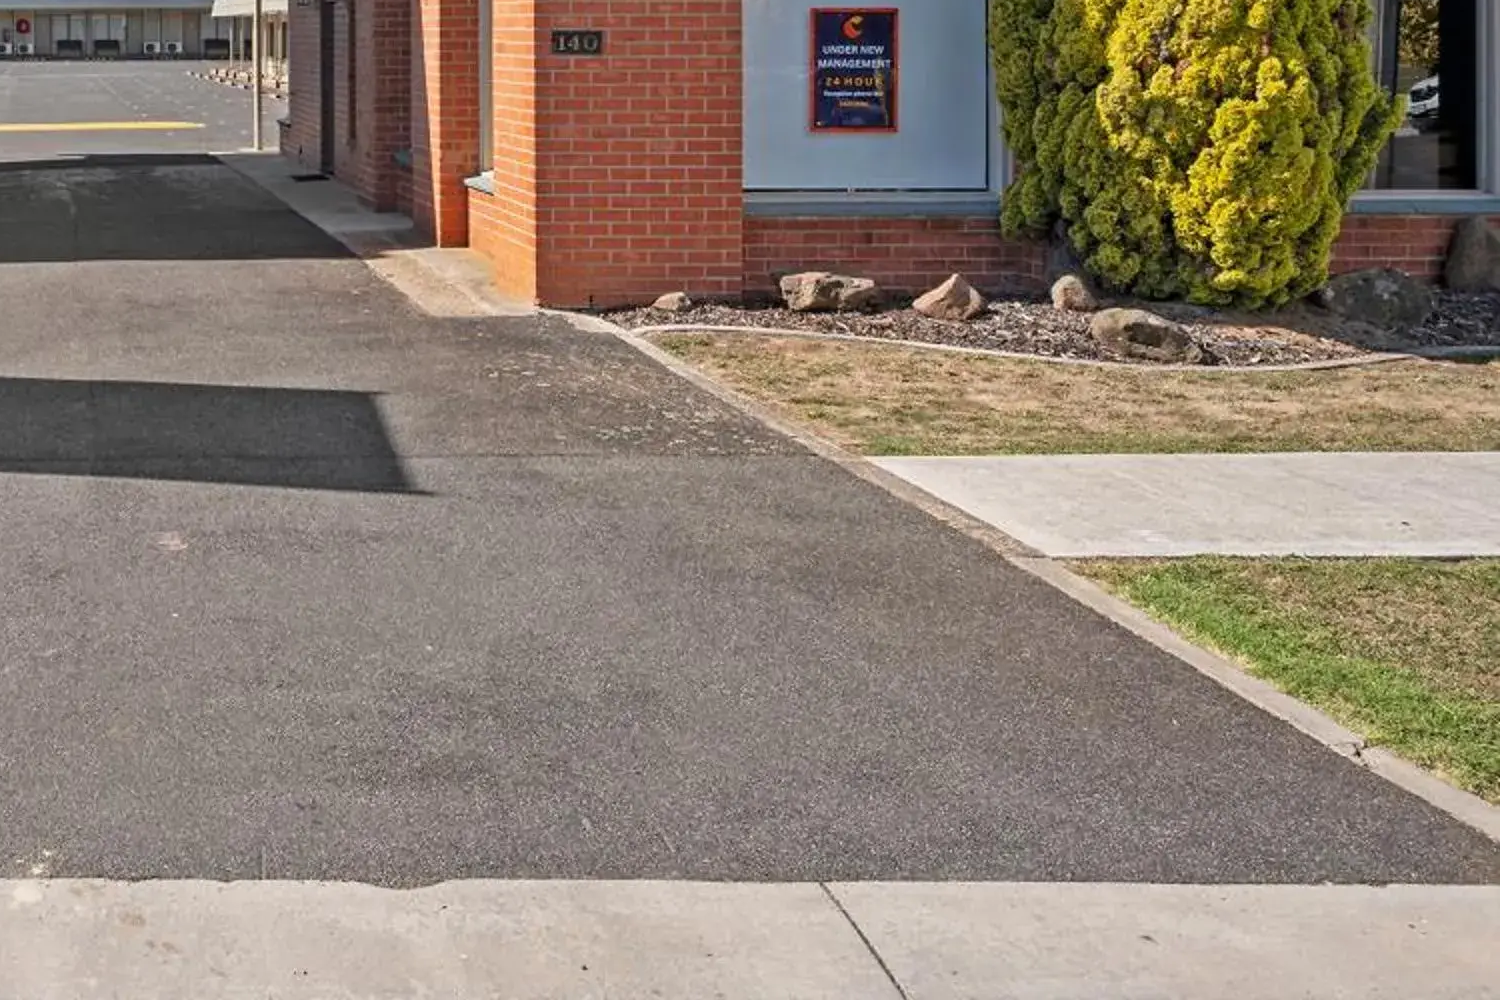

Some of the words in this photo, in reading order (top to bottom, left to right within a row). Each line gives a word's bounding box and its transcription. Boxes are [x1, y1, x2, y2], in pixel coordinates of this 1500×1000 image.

[555, 34, 598, 51] 140
[822, 45, 858, 54] UNDER
[860, 45, 885, 54] NEW
[818, 59, 891, 68] MANAGEMENT
